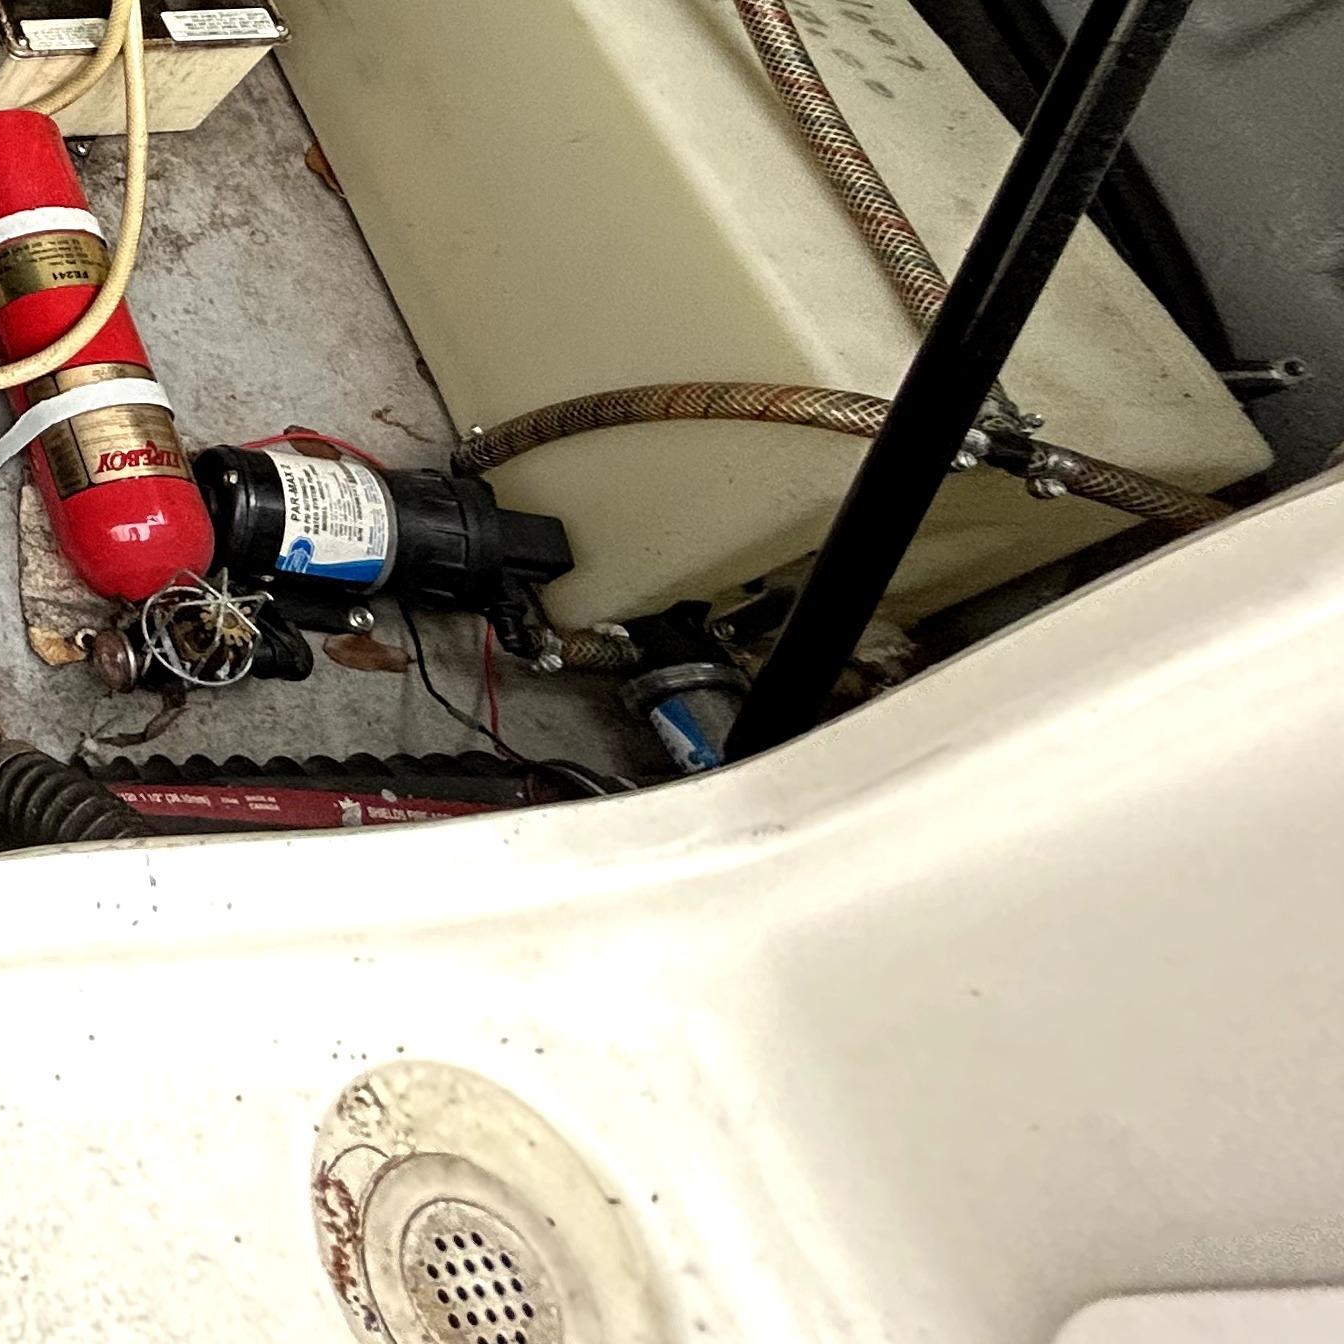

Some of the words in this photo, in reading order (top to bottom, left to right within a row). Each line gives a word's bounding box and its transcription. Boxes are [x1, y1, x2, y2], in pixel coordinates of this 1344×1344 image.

[51, 270, 89, 281] FE241
[94, 439, 182, 474] FIREBOY
[366, 805, 407, 821] SHIELDS
